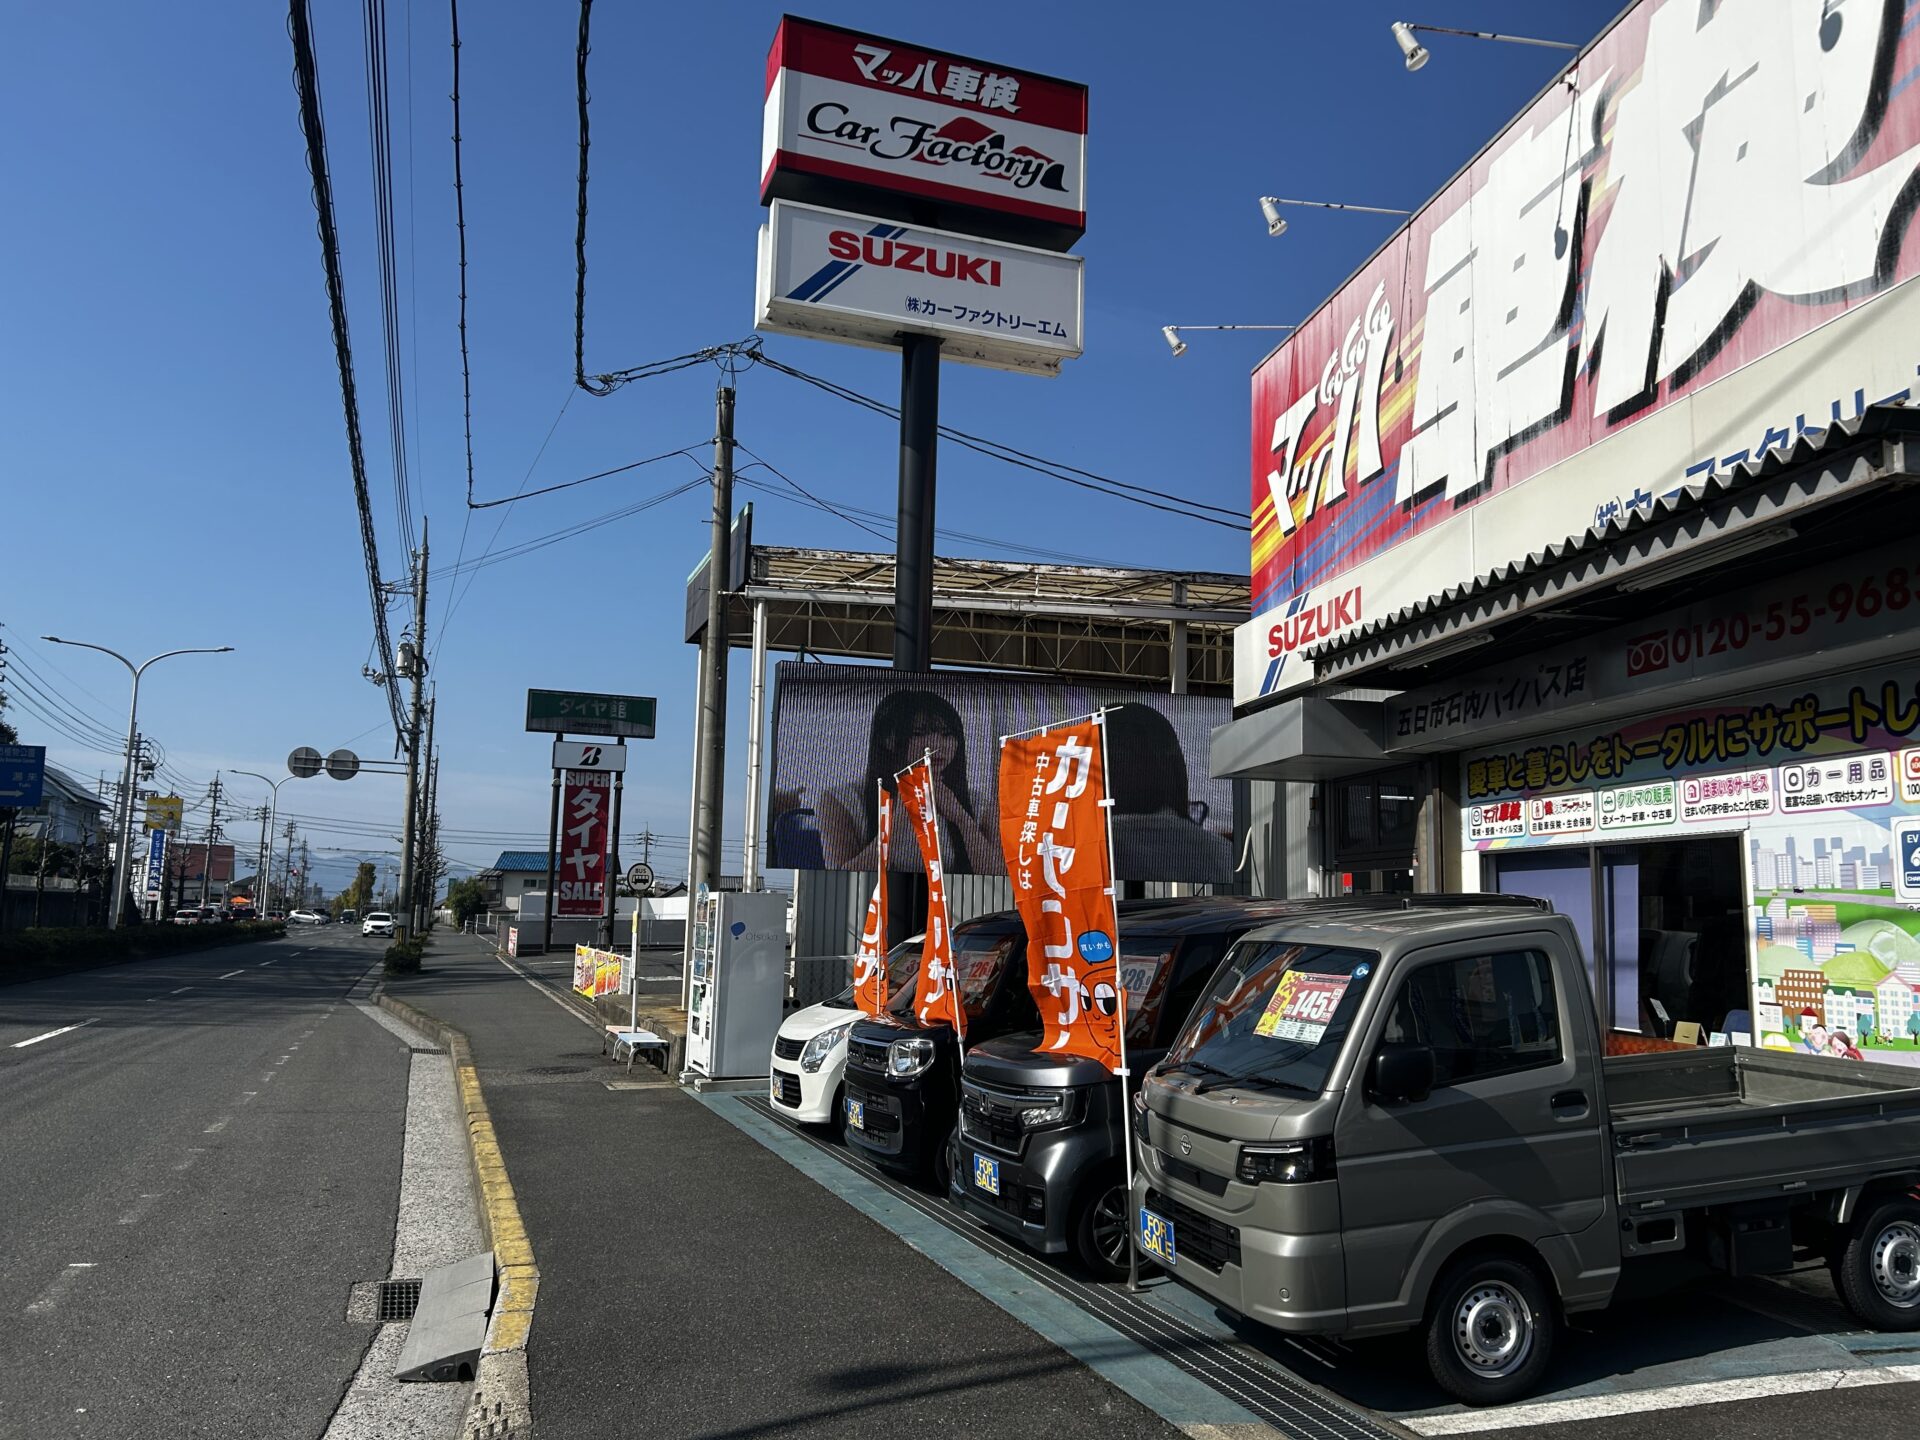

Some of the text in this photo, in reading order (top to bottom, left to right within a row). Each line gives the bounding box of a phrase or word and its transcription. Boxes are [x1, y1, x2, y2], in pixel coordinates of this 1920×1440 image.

[852, 43, 1022, 114] マッハ車検
[806, 102, 1046, 188] Car Factory
[828, 230, 1001, 287] SUZUKI
[1268, 585, 1362, 658] SUZUKI
[1671, 562, 1920, 663] 0120-55-968
[559, 697, 627, 719] タイヤ館
[1397, 655, 1588, 738] 五日市石内バイパス店
[1468, 683, 1920, 797] 愛車と暮らしをトータルにサポートし
[566, 771, 610, 788] SUPER
[1702, 773, 1769, 799] 住まいるサービス
[1807, 758, 1887, 787] カー用品
[1616, 784, 1673, 808] クルマの販売
[565, 788, 602, 880] タイヤ
[1018, 752, 1050, 890] 中古車探しは
[560, 880, 603, 901] SALE
[745, 932, 778, 942] Otsuka
[1291, 989, 1336, 1019] 145.0
[978, 1157, 993, 1176] FOR
[975, 1172, 997, 1192] SALE
[1147, 1215, 1167, 1240] FOR
[1143, 1229, 1173, 1260] SALE
